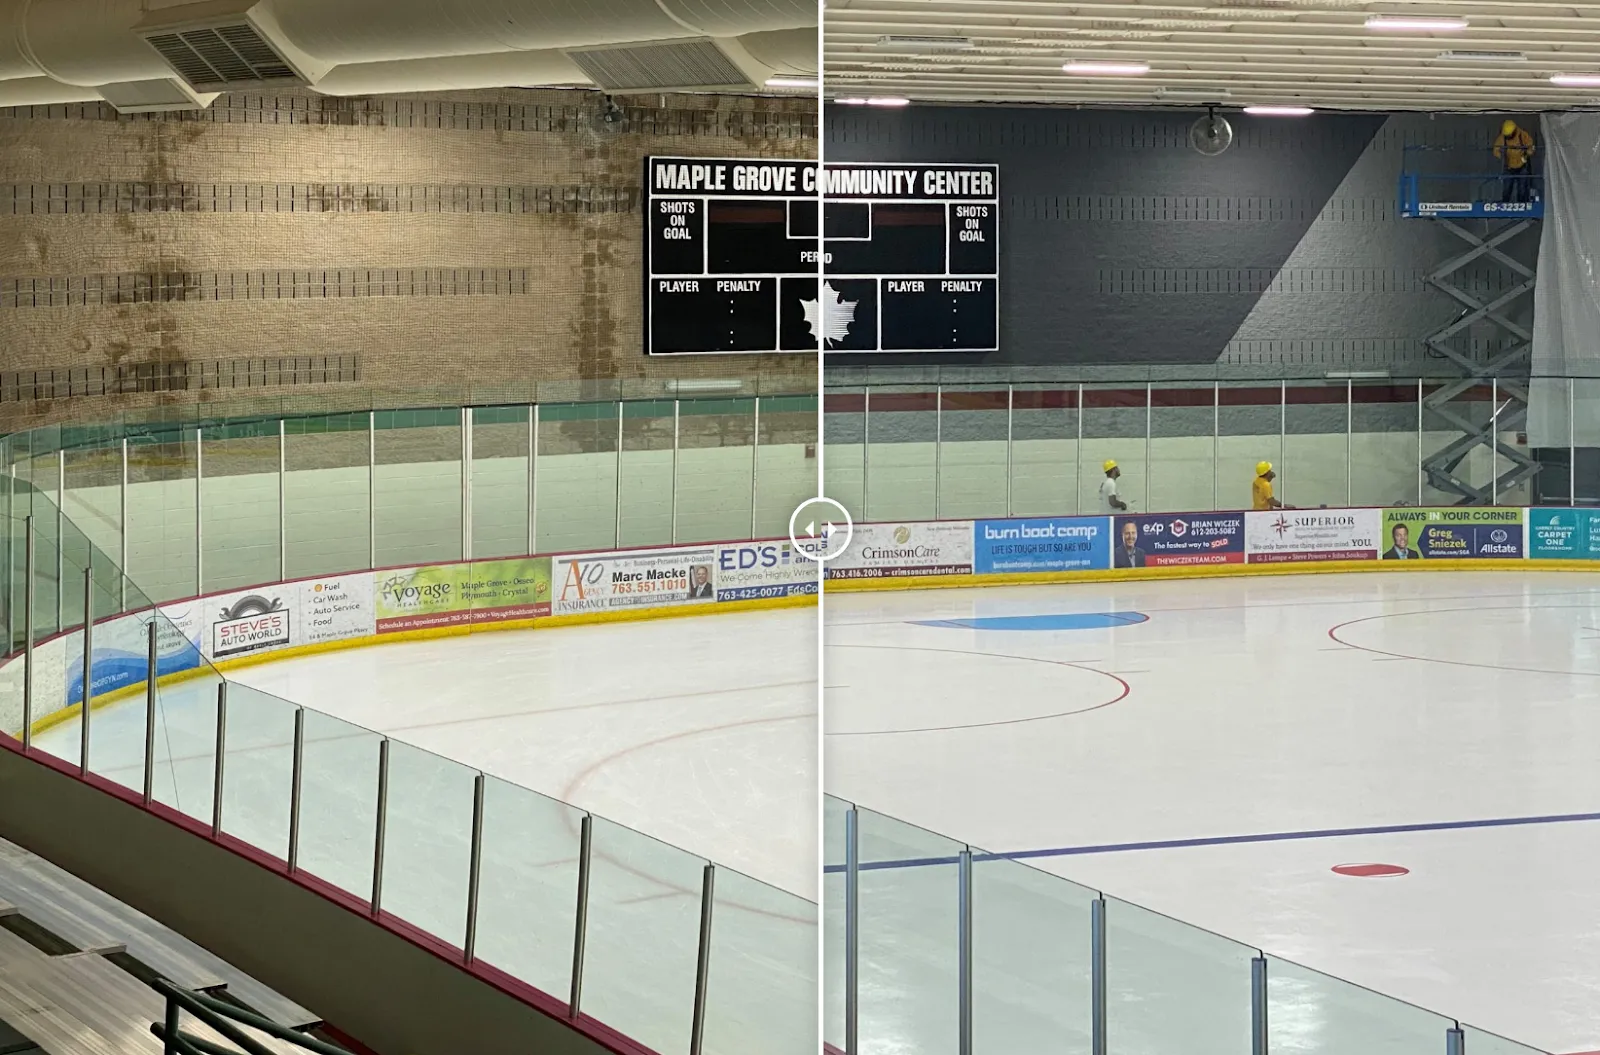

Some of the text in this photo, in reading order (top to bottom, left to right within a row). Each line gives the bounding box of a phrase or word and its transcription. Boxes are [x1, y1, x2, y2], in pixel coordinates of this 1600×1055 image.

[656, 164, 726, 190] MAPLE
[733, 165, 796, 191] GROVE
[924, 170, 993, 195] CENTER
[660, 201, 695, 213] SHOTS
[956, 206, 988, 217] SHOTS
[1483, 203, 1525, 211] GS-3232
[670, 215, 685, 226] ON
[965, 219, 979, 229] ON
[663, 228, 691, 239] GOAL
[959, 230, 985, 242] GOAL
[800, 251, 833, 264] PERD
[659, 281, 699, 292] PLAYER
[716, 280, 761, 292] PENALTY
[888, 281, 925, 292] PLAYER
[941, 280, 982, 292] PENALTY
[1295, 516, 1355, 526] SUPERIOR
[1388, 511, 1517, 521] ALWAYS IN YOUR CORNER
[985, 523, 1097, 540] burn boot camp
[1191, 527, 1236, 536] 612-203-5082
[1428, 528, 1452, 539] Greg
[991, 542, 1092, 555] LIFE IS TOUGH BUT SO ARE YOU
[1166, 541, 1187, 549] fastest
[1211, 538, 1228, 548] SOLD
[1428, 539, 1467, 548] Sniezek
[1480, 544, 1517, 553] Allstate
[862, 545, 940, 559] CrimsonCare
[719, 546, 777, 570] ED'S
[1157, 556, 1227, 565] THEWICZEKTEAM.COM
[612, 568, 686, 583] Marc Macke
[765, 570, 792, 580] Highly
[831, 569, 883, 578] 763.416.2006
[324, 582, 340, 591] Fuel
[503, 587, 528, 597] Crystal
[611, 578, 687, 595] 763.551.1010
[393, 583, 451, 602] Voyage
[718, 586, 784, 600] 763-425-0077
[313, 593, 348, 604] Car Wash
[313, 603, 360, 615] Auto Service
[221, 616, 282, 638] STEVE'S
[313, 617, 332, 626] Food
[220, 628, 282, 647] AUTO WORLD
